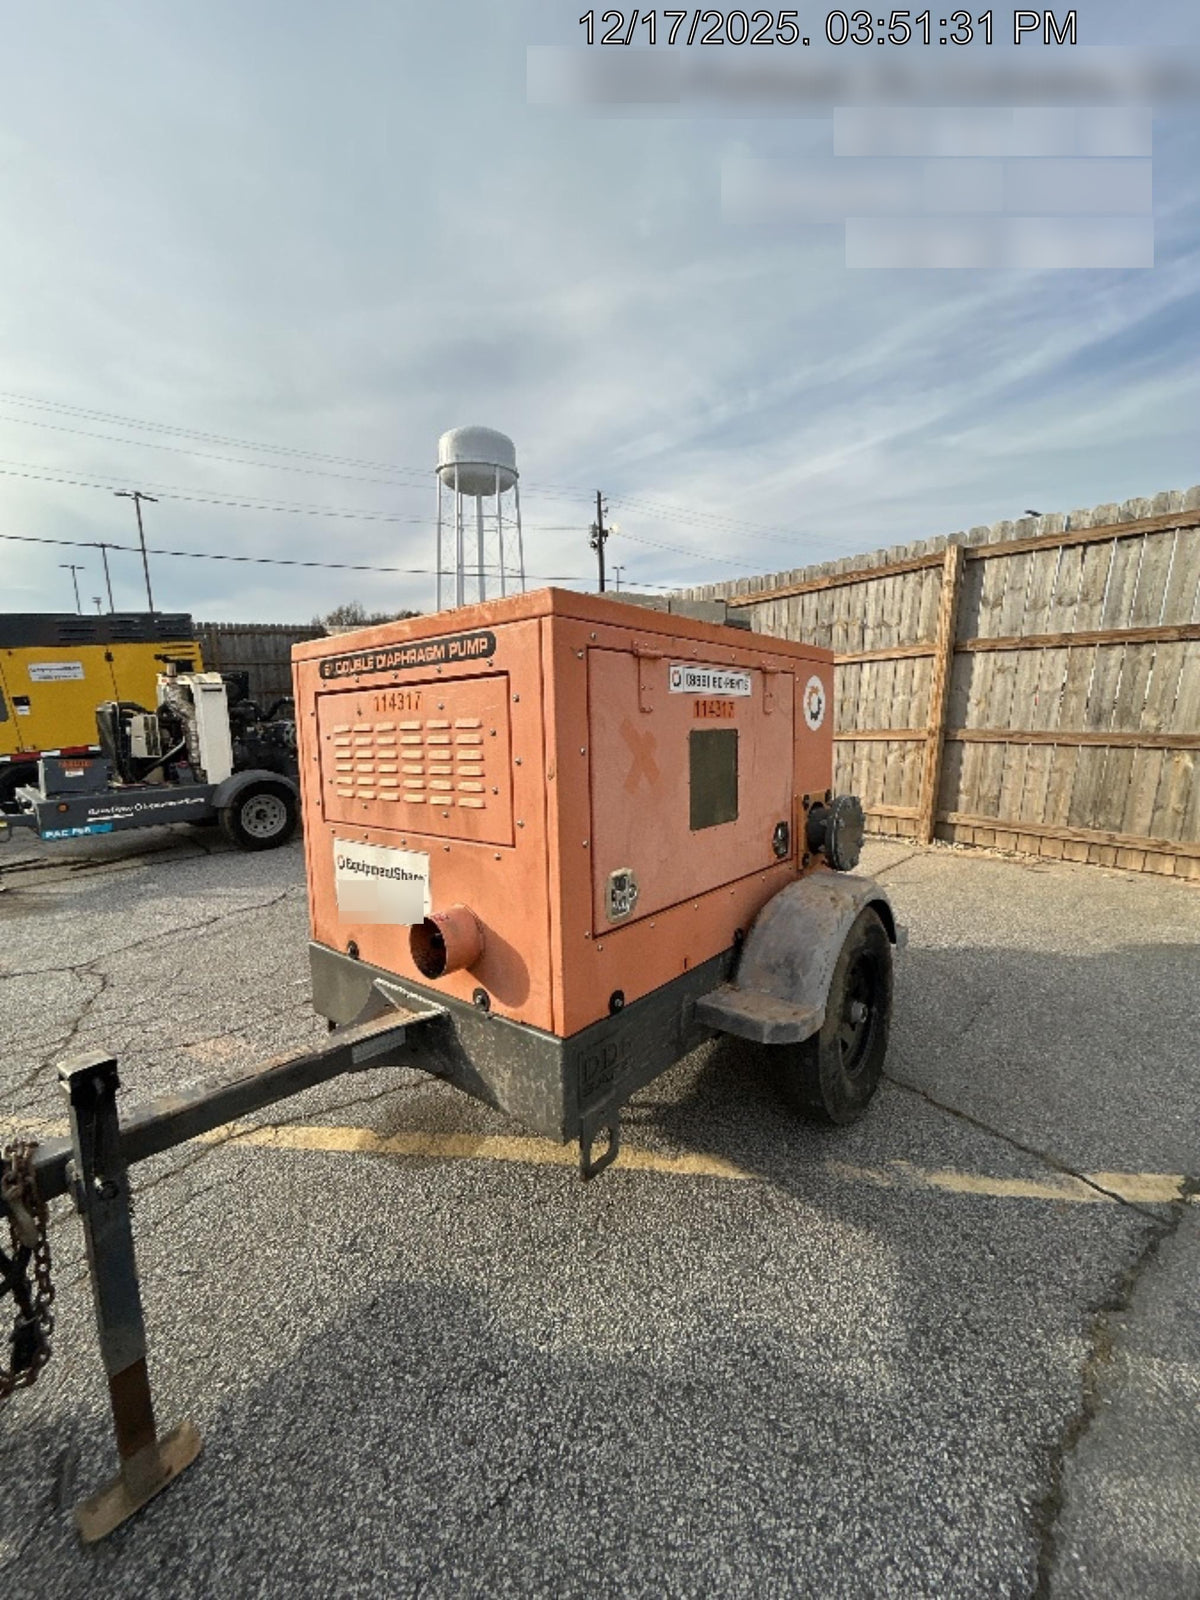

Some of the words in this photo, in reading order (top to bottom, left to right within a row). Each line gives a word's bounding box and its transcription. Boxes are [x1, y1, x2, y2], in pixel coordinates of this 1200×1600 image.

[335, 656, 374, 675] DOUBLE
[376, 645, 445, 668] DIAPHRAGM
[449, 638, 488, 658] PUMP
[374, 691, 422, 712] 114317
[693, 700, 735, 718] 114317
